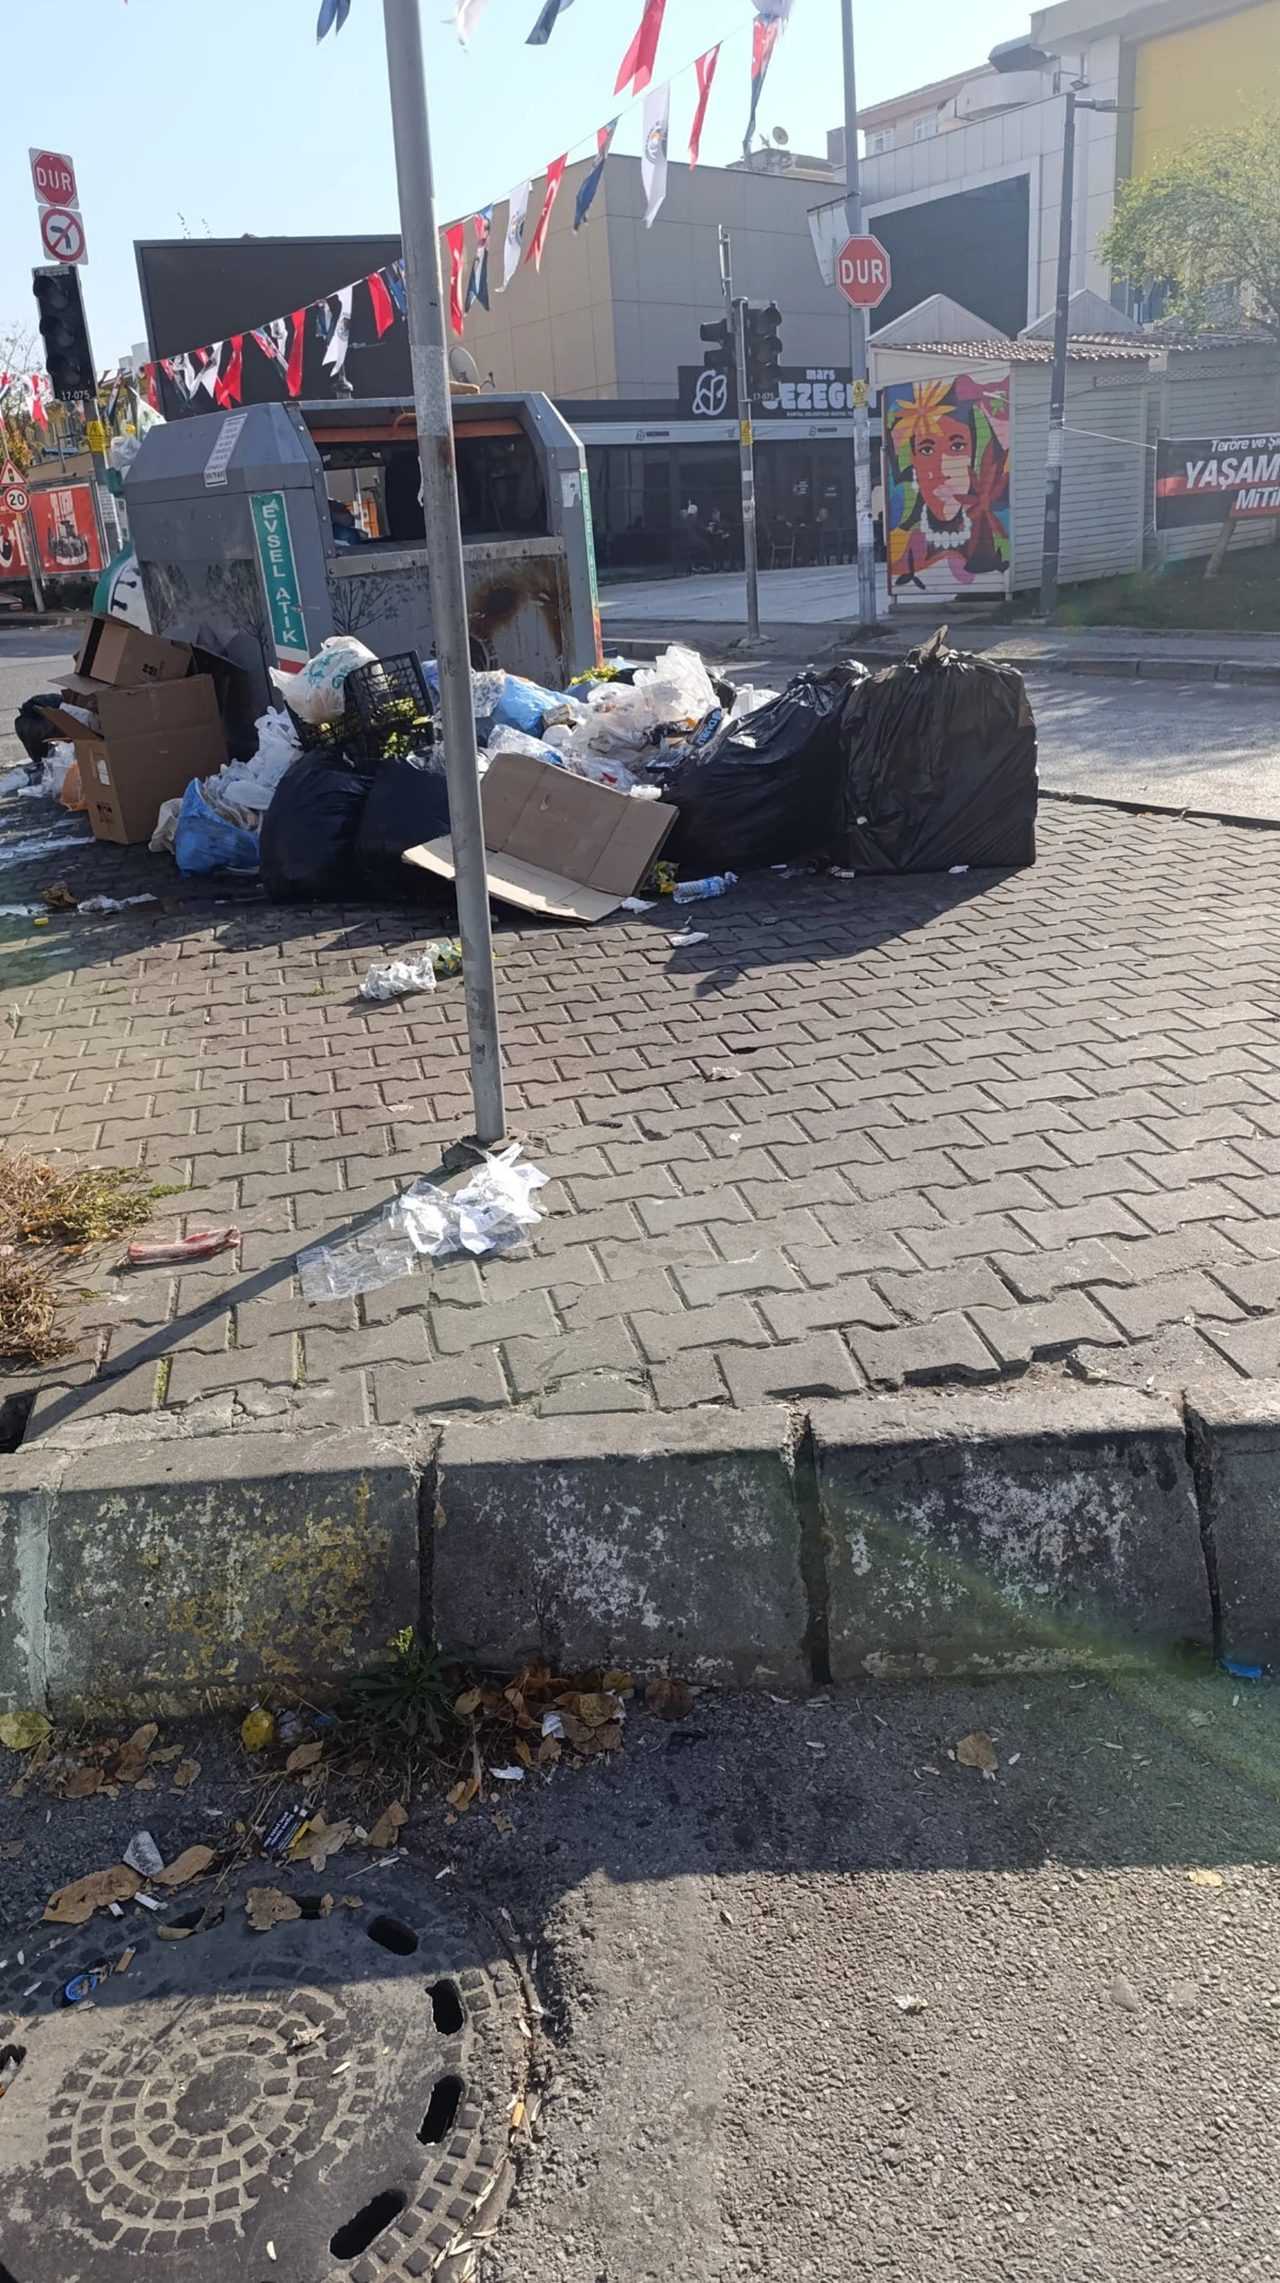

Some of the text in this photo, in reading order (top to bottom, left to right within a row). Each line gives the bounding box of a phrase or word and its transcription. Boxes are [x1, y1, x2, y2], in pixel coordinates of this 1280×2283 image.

[35, 166, 73, 192] DUR
[841, 258, 885, 285] DUR
[806, 369, 836, 380] mars
[1185, 453, 1280, 490] YAŞAM
[9, 493, 25, 506] 20
[262, 503, 286, 578] EVSEL
[275, 586, 298, 644] ATIK
